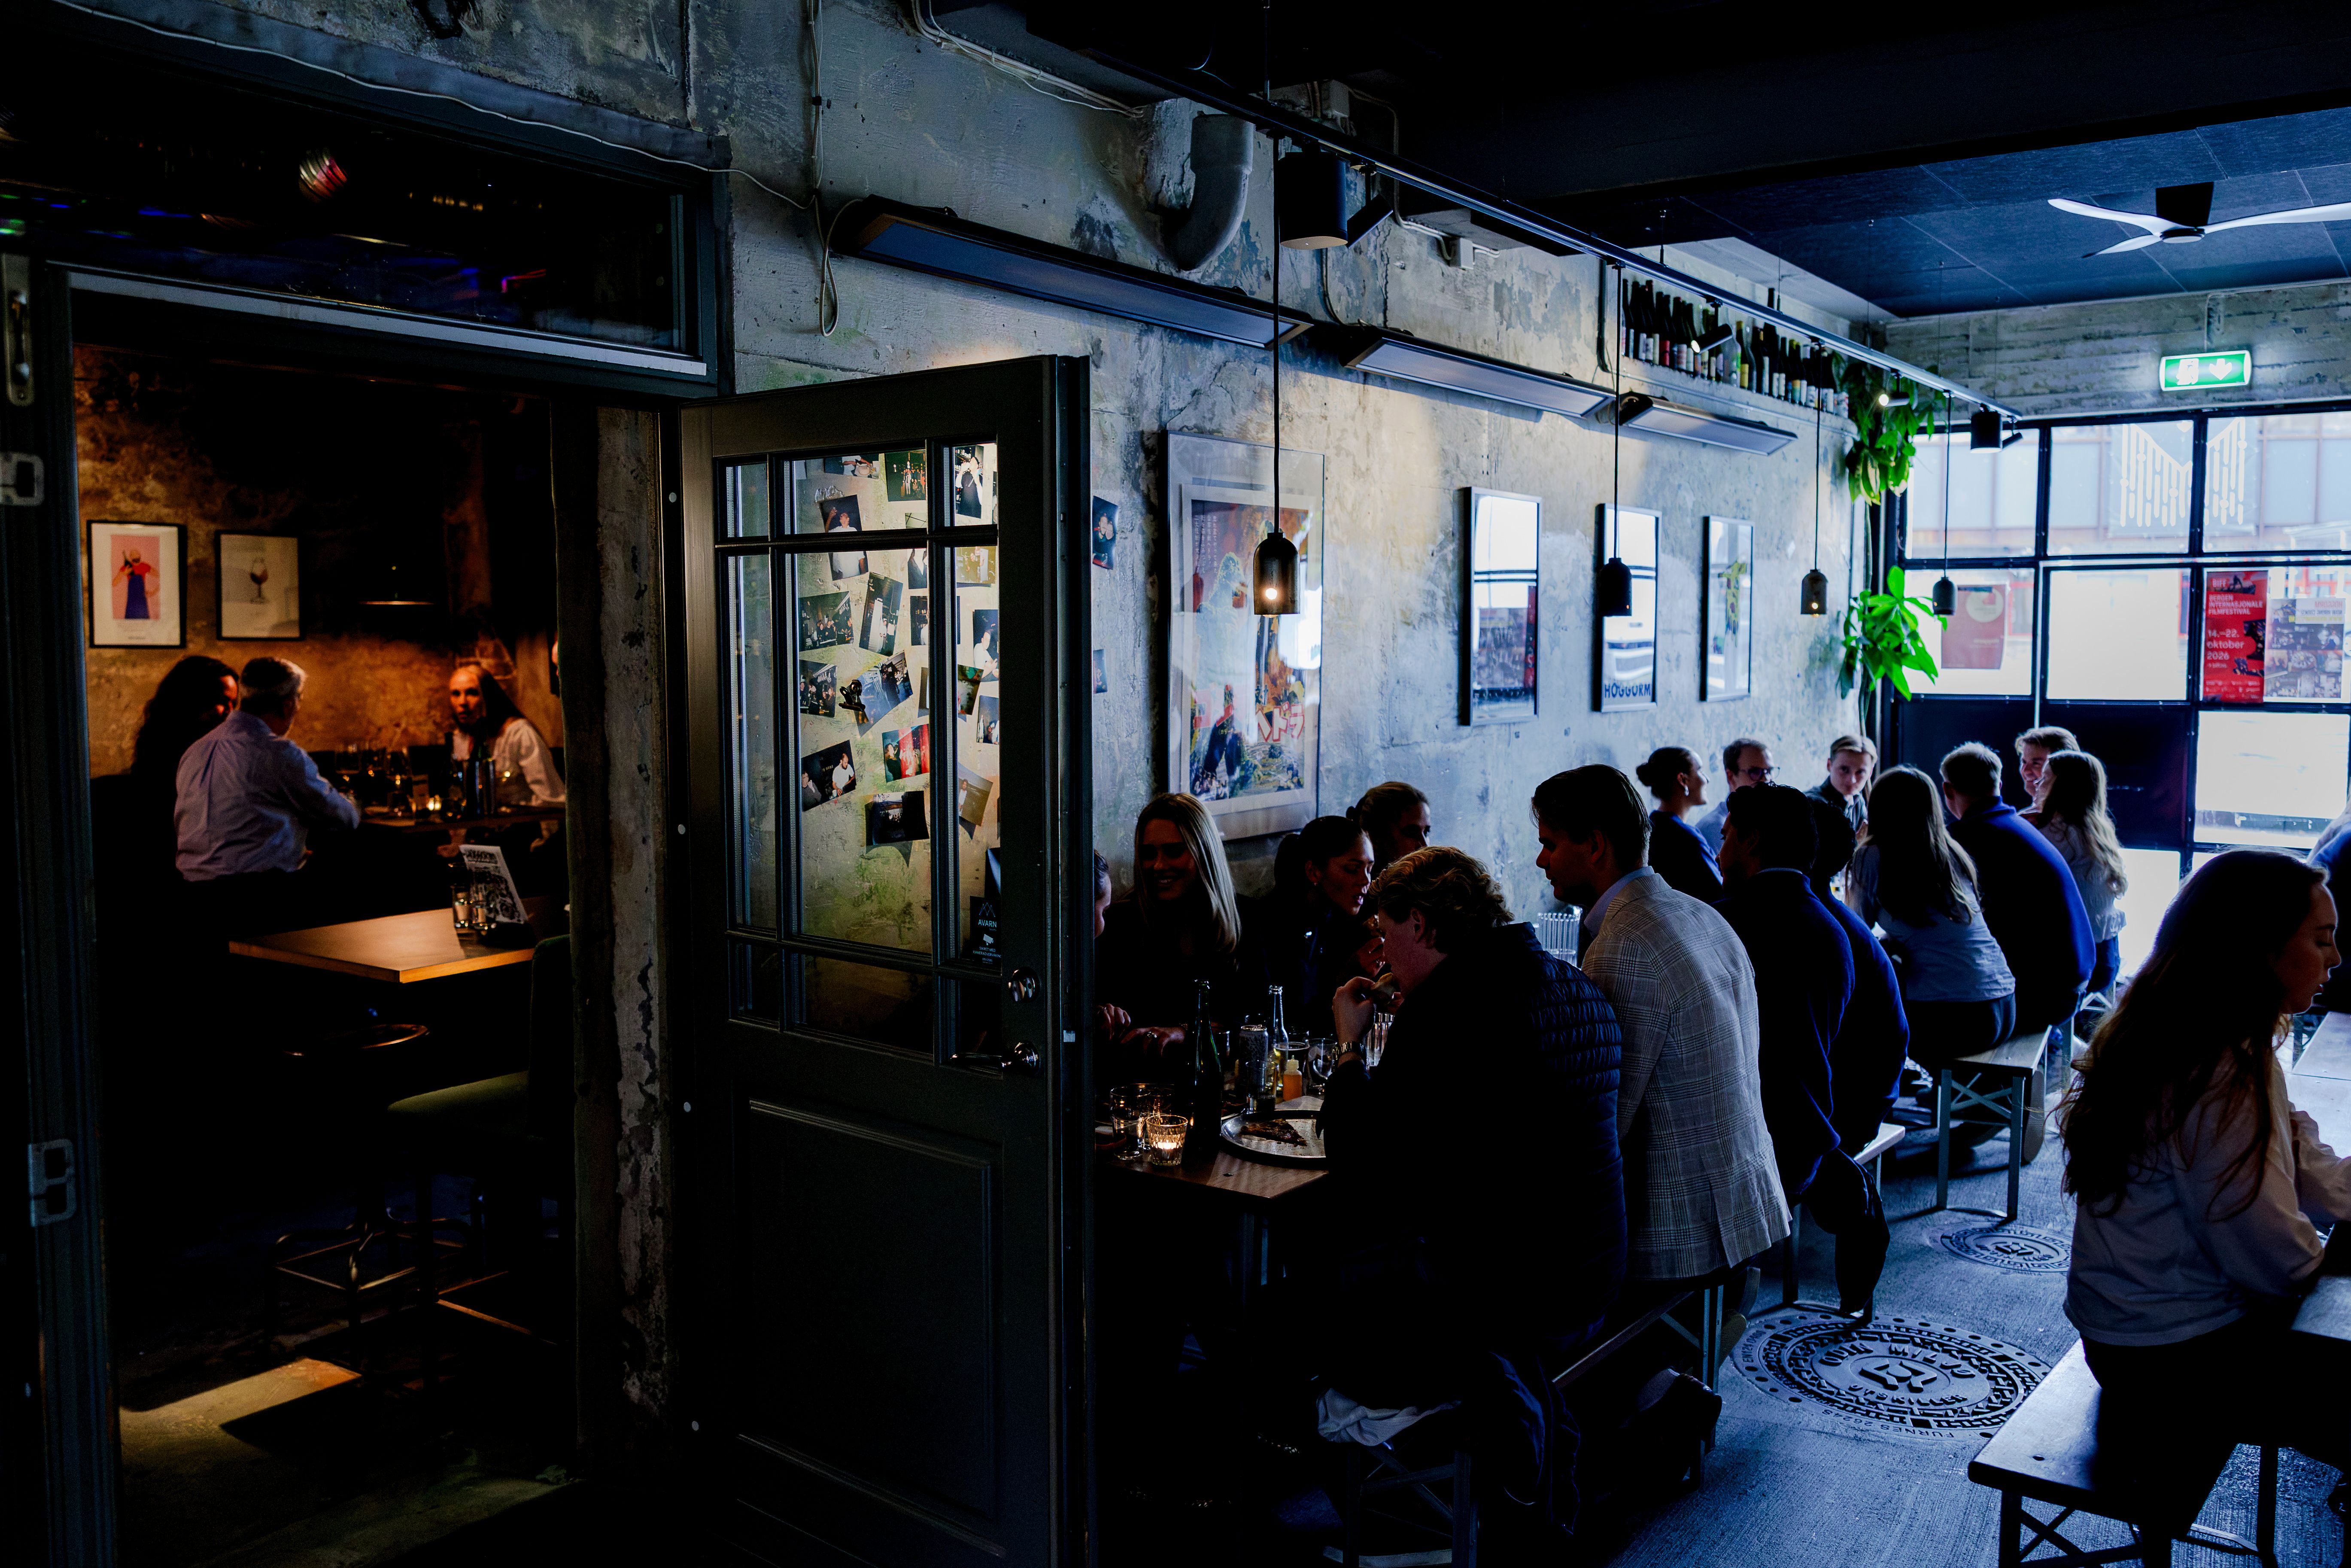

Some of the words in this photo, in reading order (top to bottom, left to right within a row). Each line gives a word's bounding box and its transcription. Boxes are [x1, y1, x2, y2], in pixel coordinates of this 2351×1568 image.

[2212, 578, 2226, 588] BIFF
[2207, 639, 2245, 649] oktober
[2207, 651, 2230, 660] 2026
[1604, 683, 1651, 698] HOGGORM
[978, 919, 997, 928] AVARN
[1741, 1343, 1754, 1363] EN124
[1819, 1342, 1874, 1366] ODIN
[1848, 1384, 1968, 1406] UTSKILLER
[1880, 1423, 1955, 1438] FURNES
